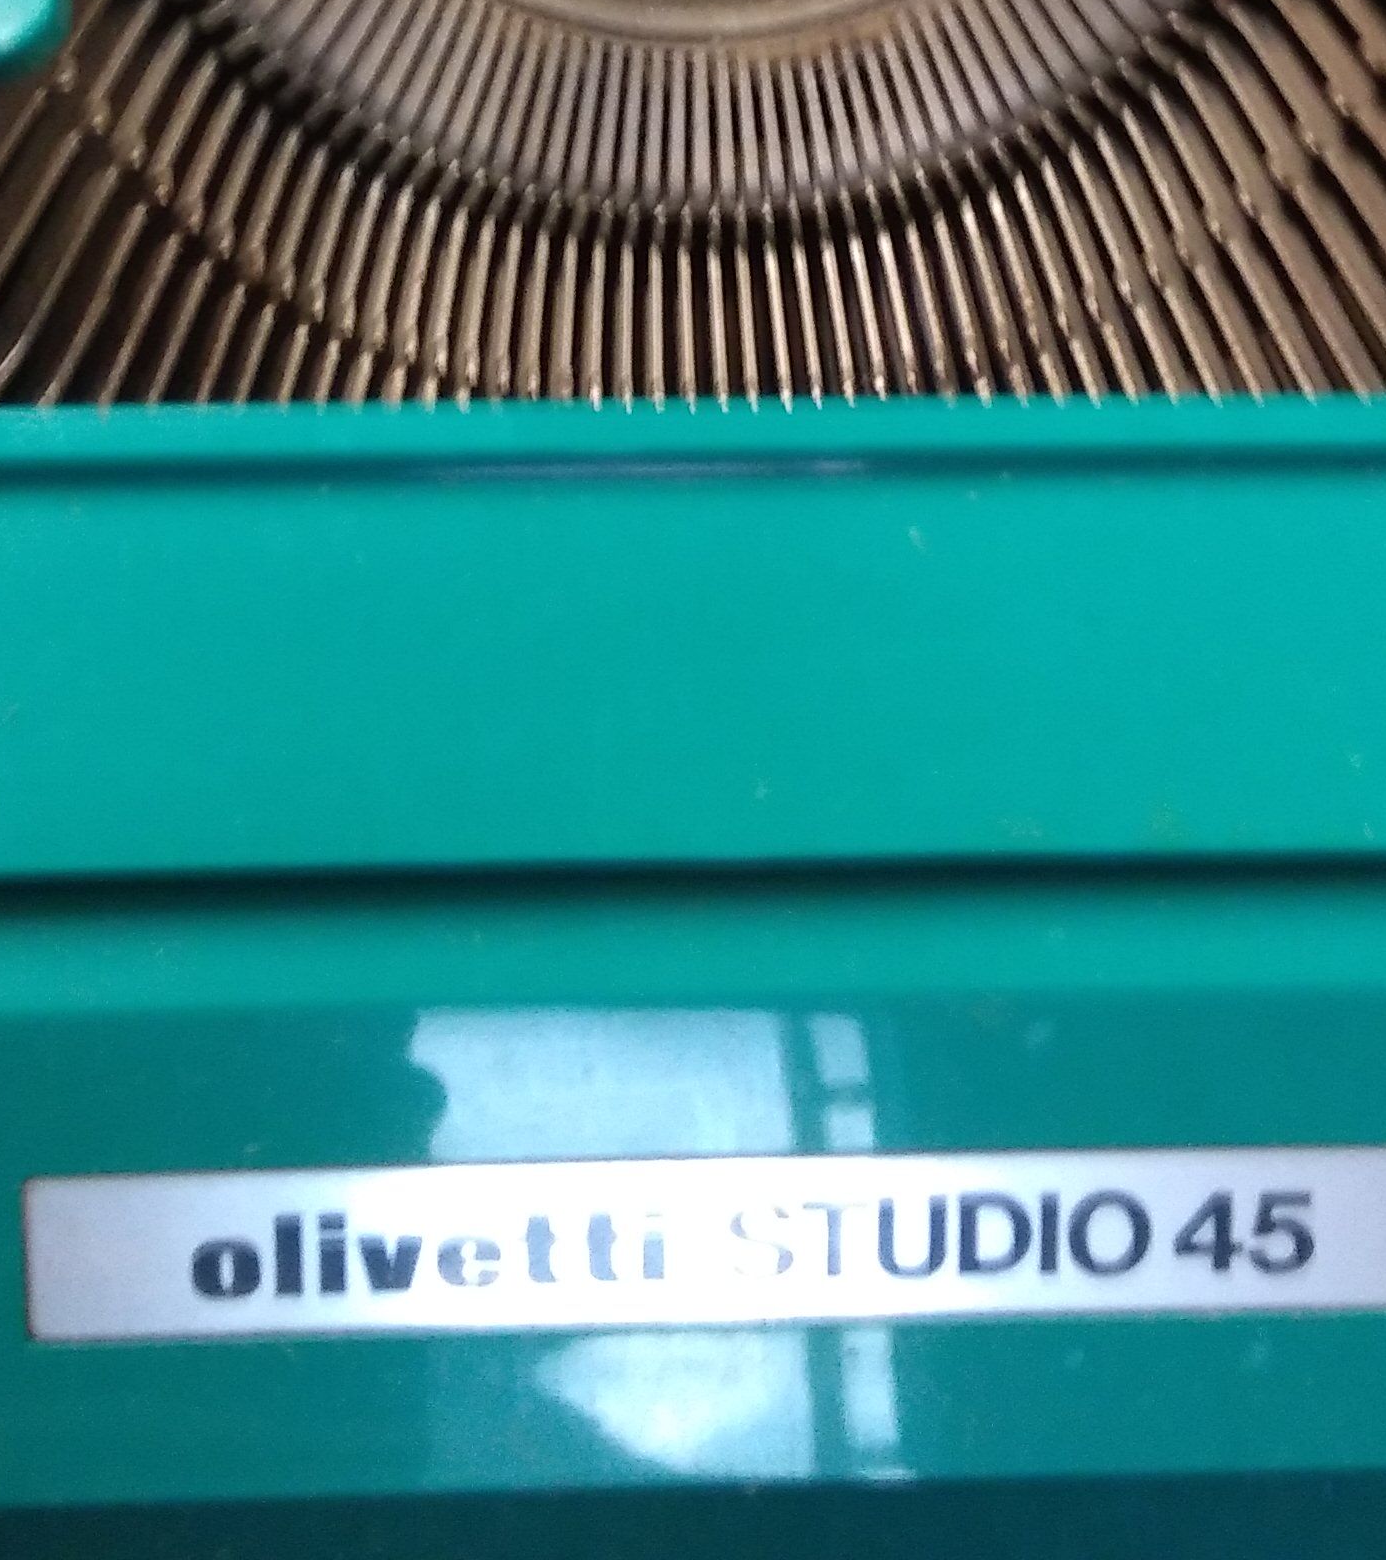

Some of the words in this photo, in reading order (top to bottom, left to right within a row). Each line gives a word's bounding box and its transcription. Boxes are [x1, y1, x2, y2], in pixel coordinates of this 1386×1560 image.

[191, 1210, 665, 1298] olivetti
[729, 1190, 1151, 1278] STUDIO
[1173, 1190, 1315, 1275] 45
